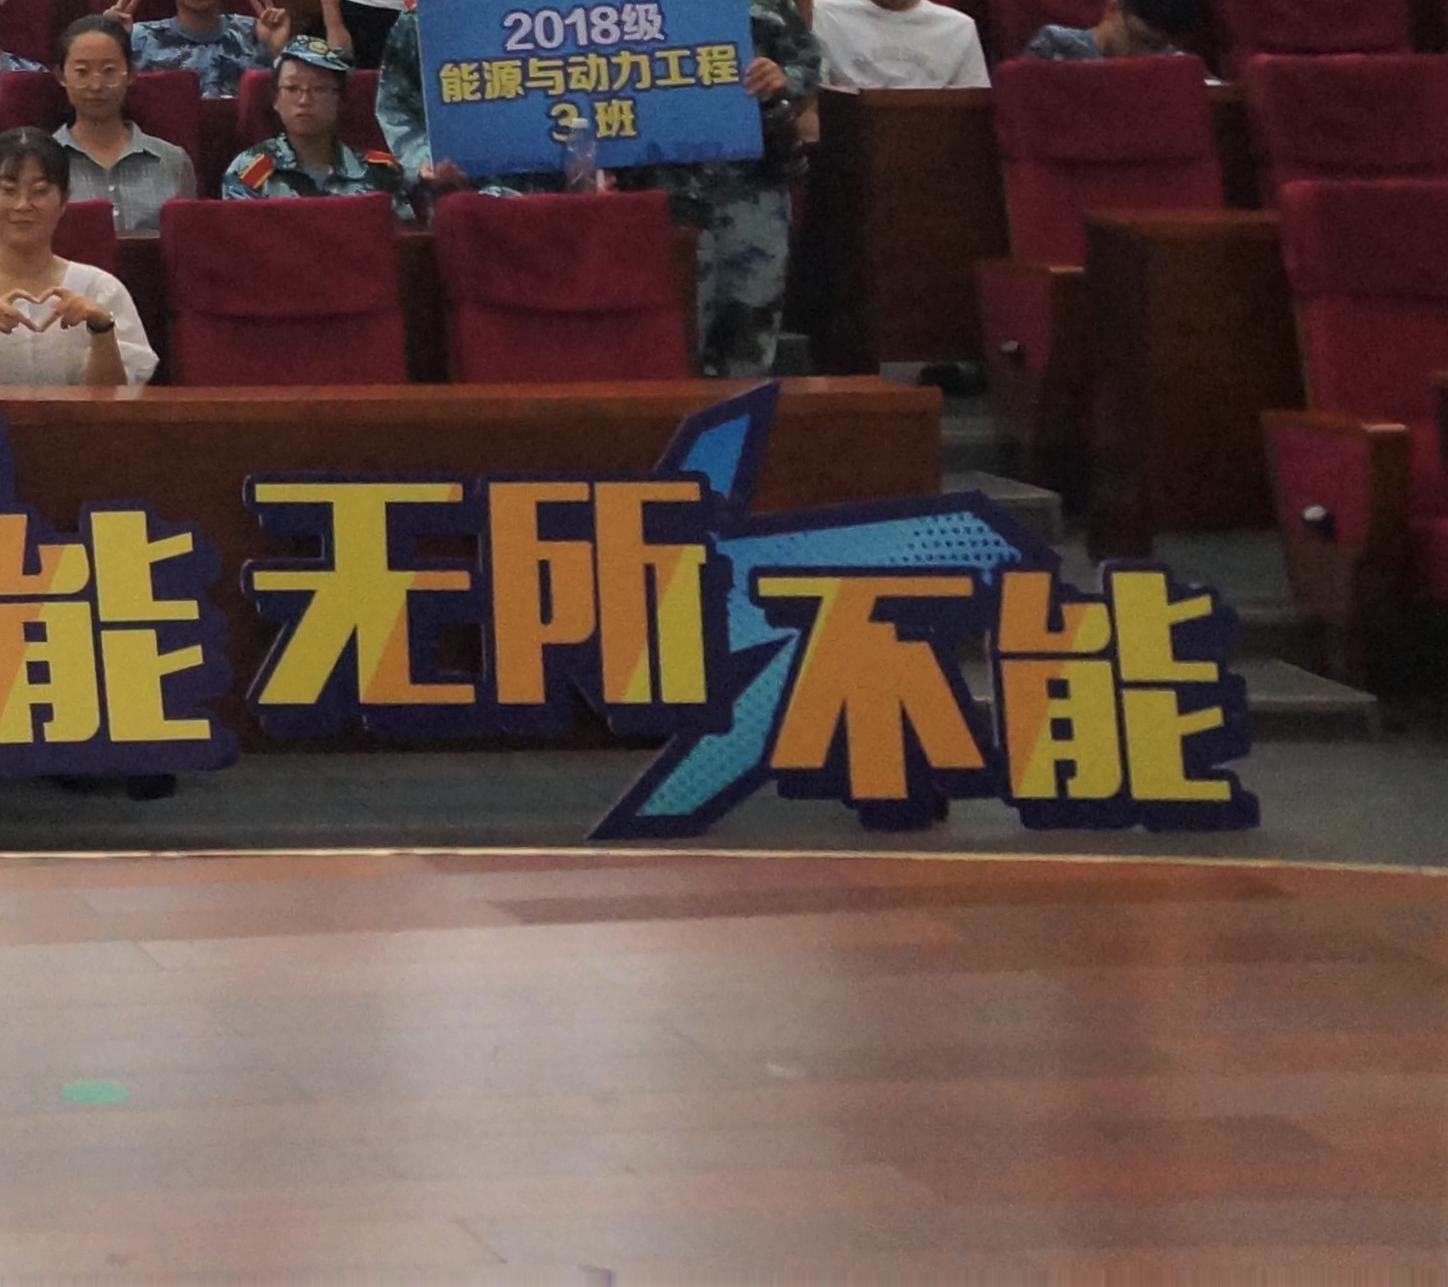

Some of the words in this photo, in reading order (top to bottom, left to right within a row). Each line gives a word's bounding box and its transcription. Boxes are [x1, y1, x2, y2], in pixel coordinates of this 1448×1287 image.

[503, 2, 665, 51] 2018级
[439, 43, 741, 104] 能源与动力工程
[253, 482, 1231, 801] 无所不能
